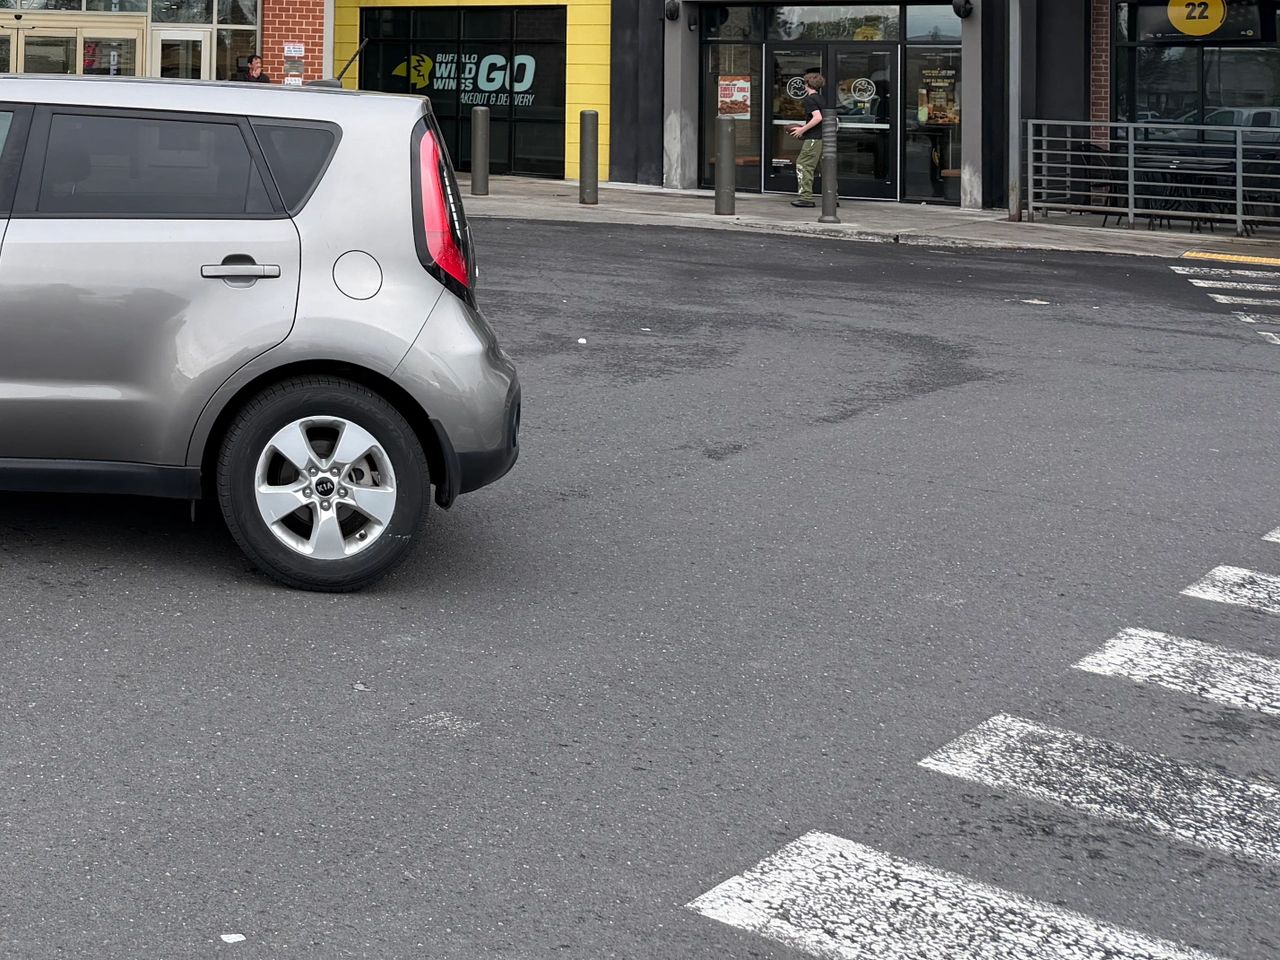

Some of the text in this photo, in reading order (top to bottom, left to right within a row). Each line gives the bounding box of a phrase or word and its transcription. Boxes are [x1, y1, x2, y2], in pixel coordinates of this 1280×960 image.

[1184, 1, 1209, 20] 22
[435, 63, 477, 79] WID
[477, 54, 536, 92] GO
[460, 92, 489, 105] AKEOUT
[497, 93, 535, 106] DEVERY
[316, 482, 334, 493] KIA
